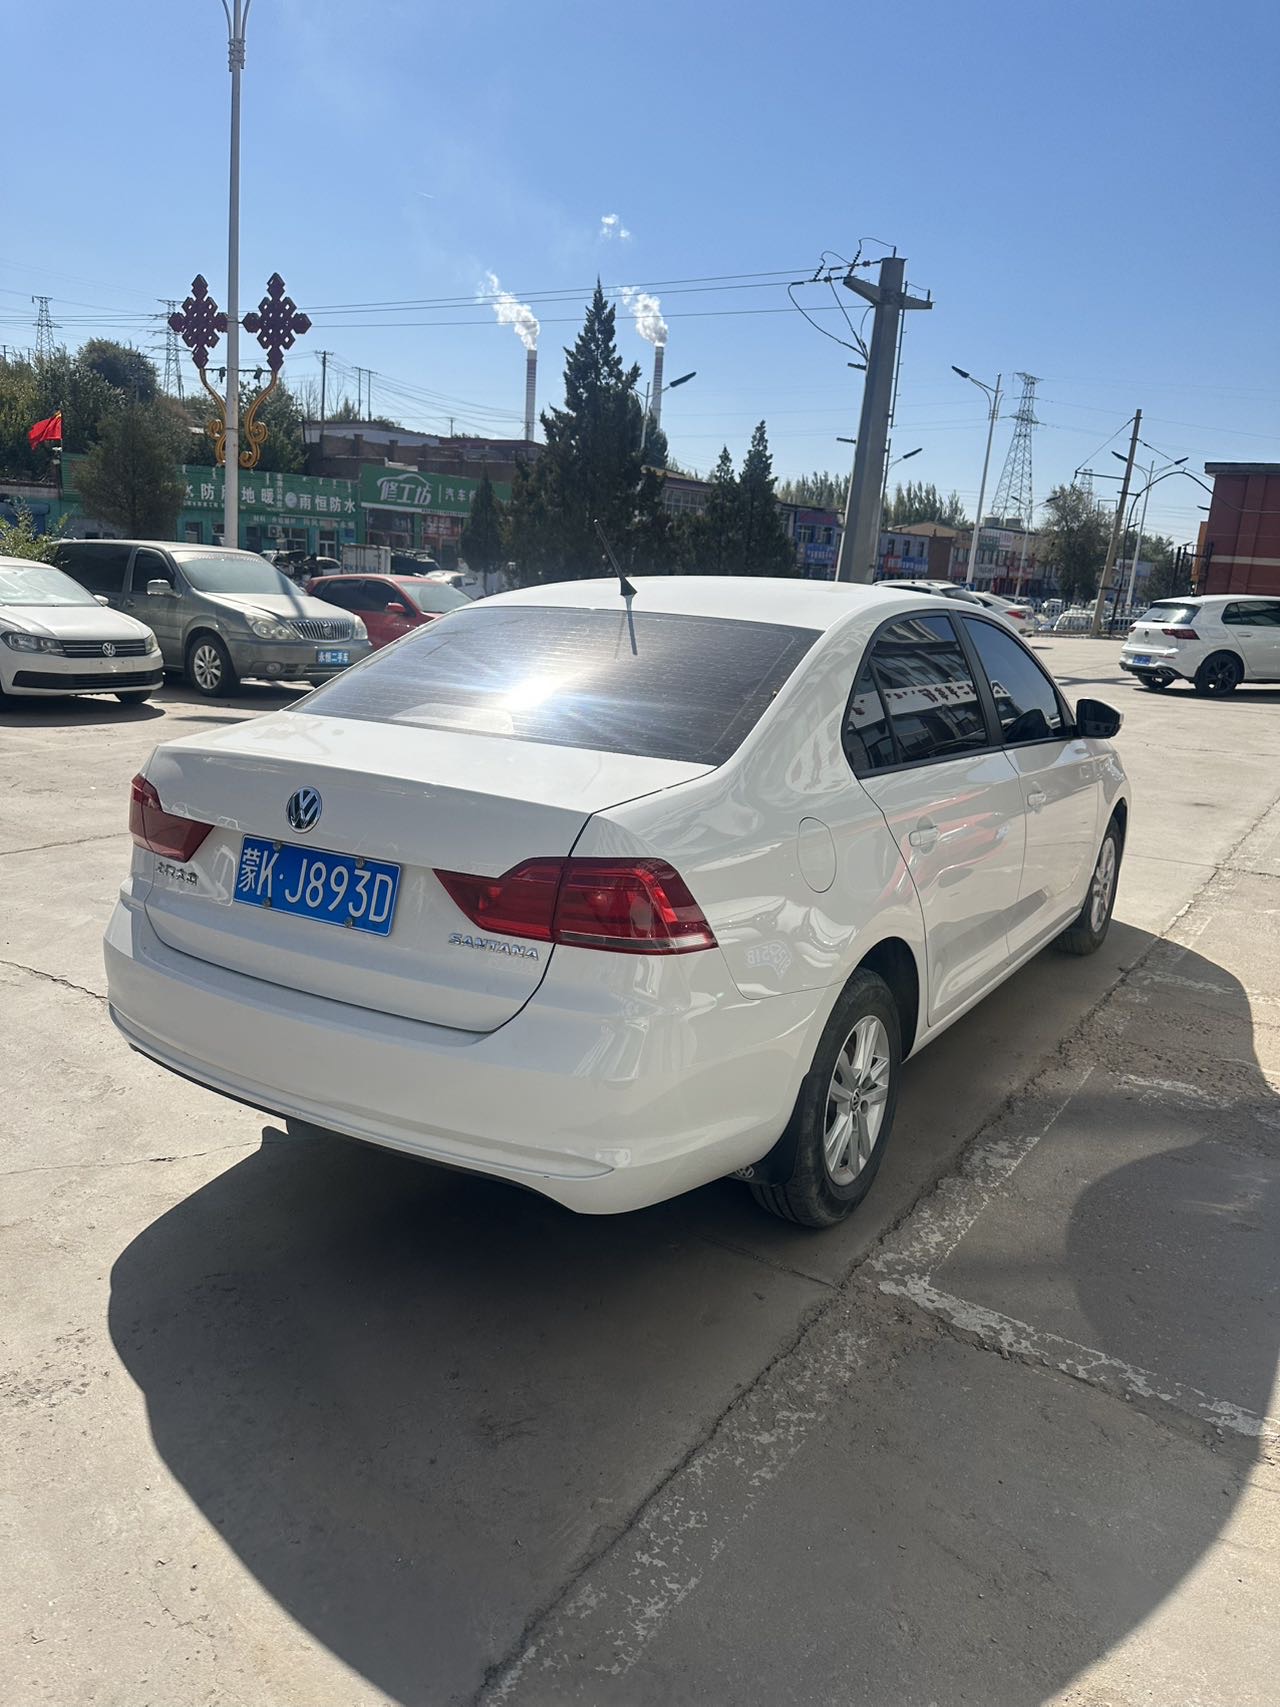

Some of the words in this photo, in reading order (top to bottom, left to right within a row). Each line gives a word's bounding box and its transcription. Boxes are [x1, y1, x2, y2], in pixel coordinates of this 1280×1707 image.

[380, 480, 432, 505] 修工坊
[238, 848, 393, 923] 蒙K·J893D
[448, 932, 539, 961] SANTANA
